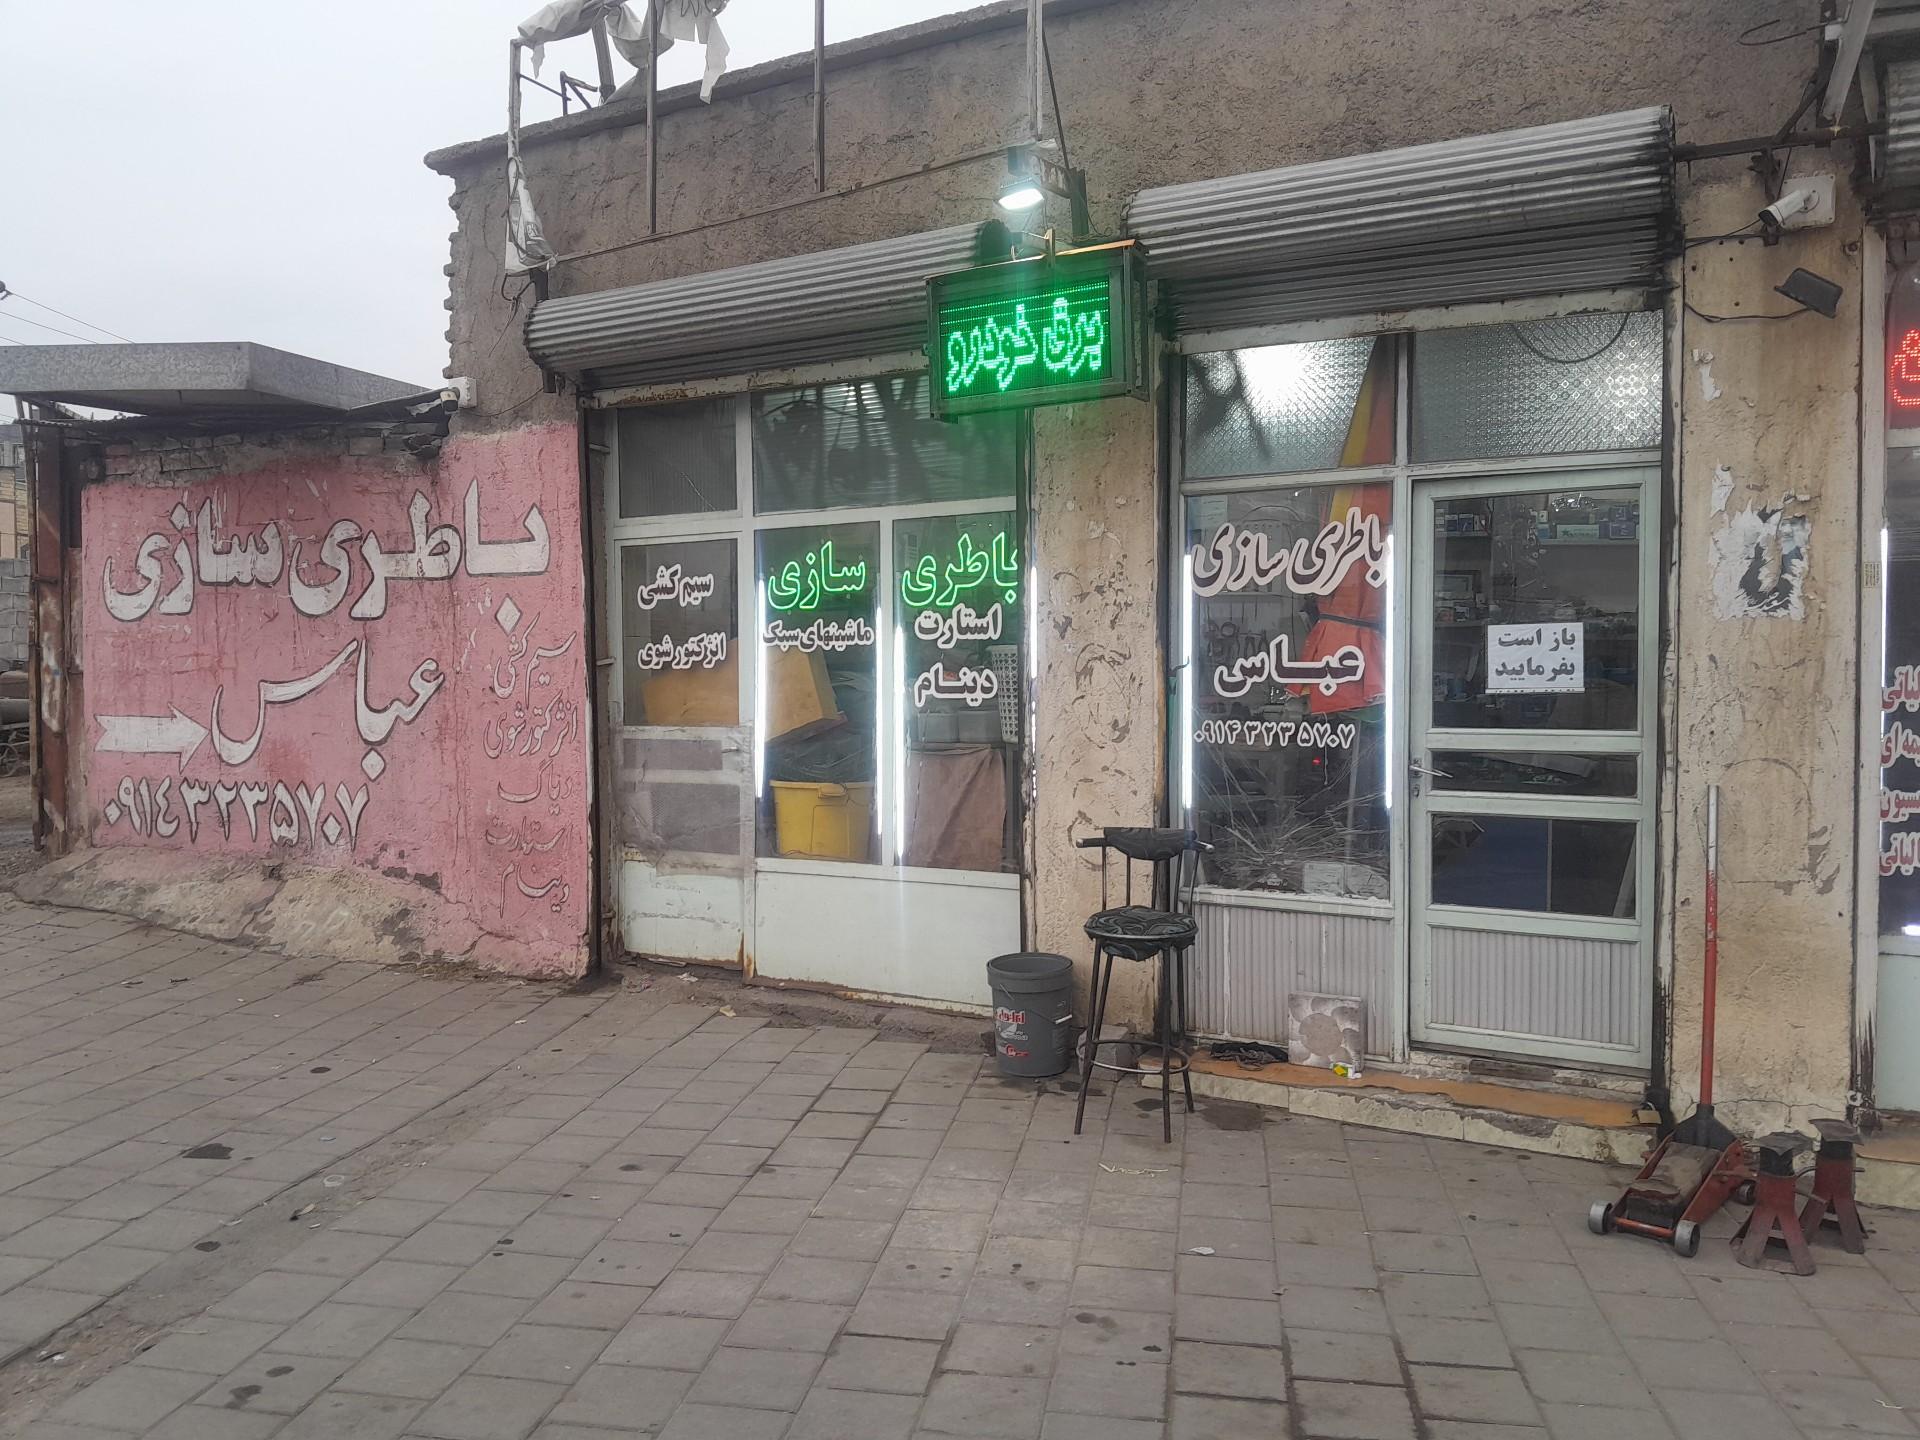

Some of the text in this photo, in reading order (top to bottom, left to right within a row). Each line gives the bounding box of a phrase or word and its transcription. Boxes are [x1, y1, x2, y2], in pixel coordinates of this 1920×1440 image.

[945, 303, 1040, 393] خودرو
[102, 478, 550, 636] باطری سازی
[637, 563, 714, 610] سیم کشی
[767, 531, 1019, 610] باطری سازی
[1191, 506, 1388, 597] باطری سازی
[914, 602, 1003, 649] استارت
[1497, 627, 1576, 652] باز است
[914, 662, 998, 707] دینام
[1213, 634, 1366, 698] عباس
[211, 638, 446, 782] عباس
